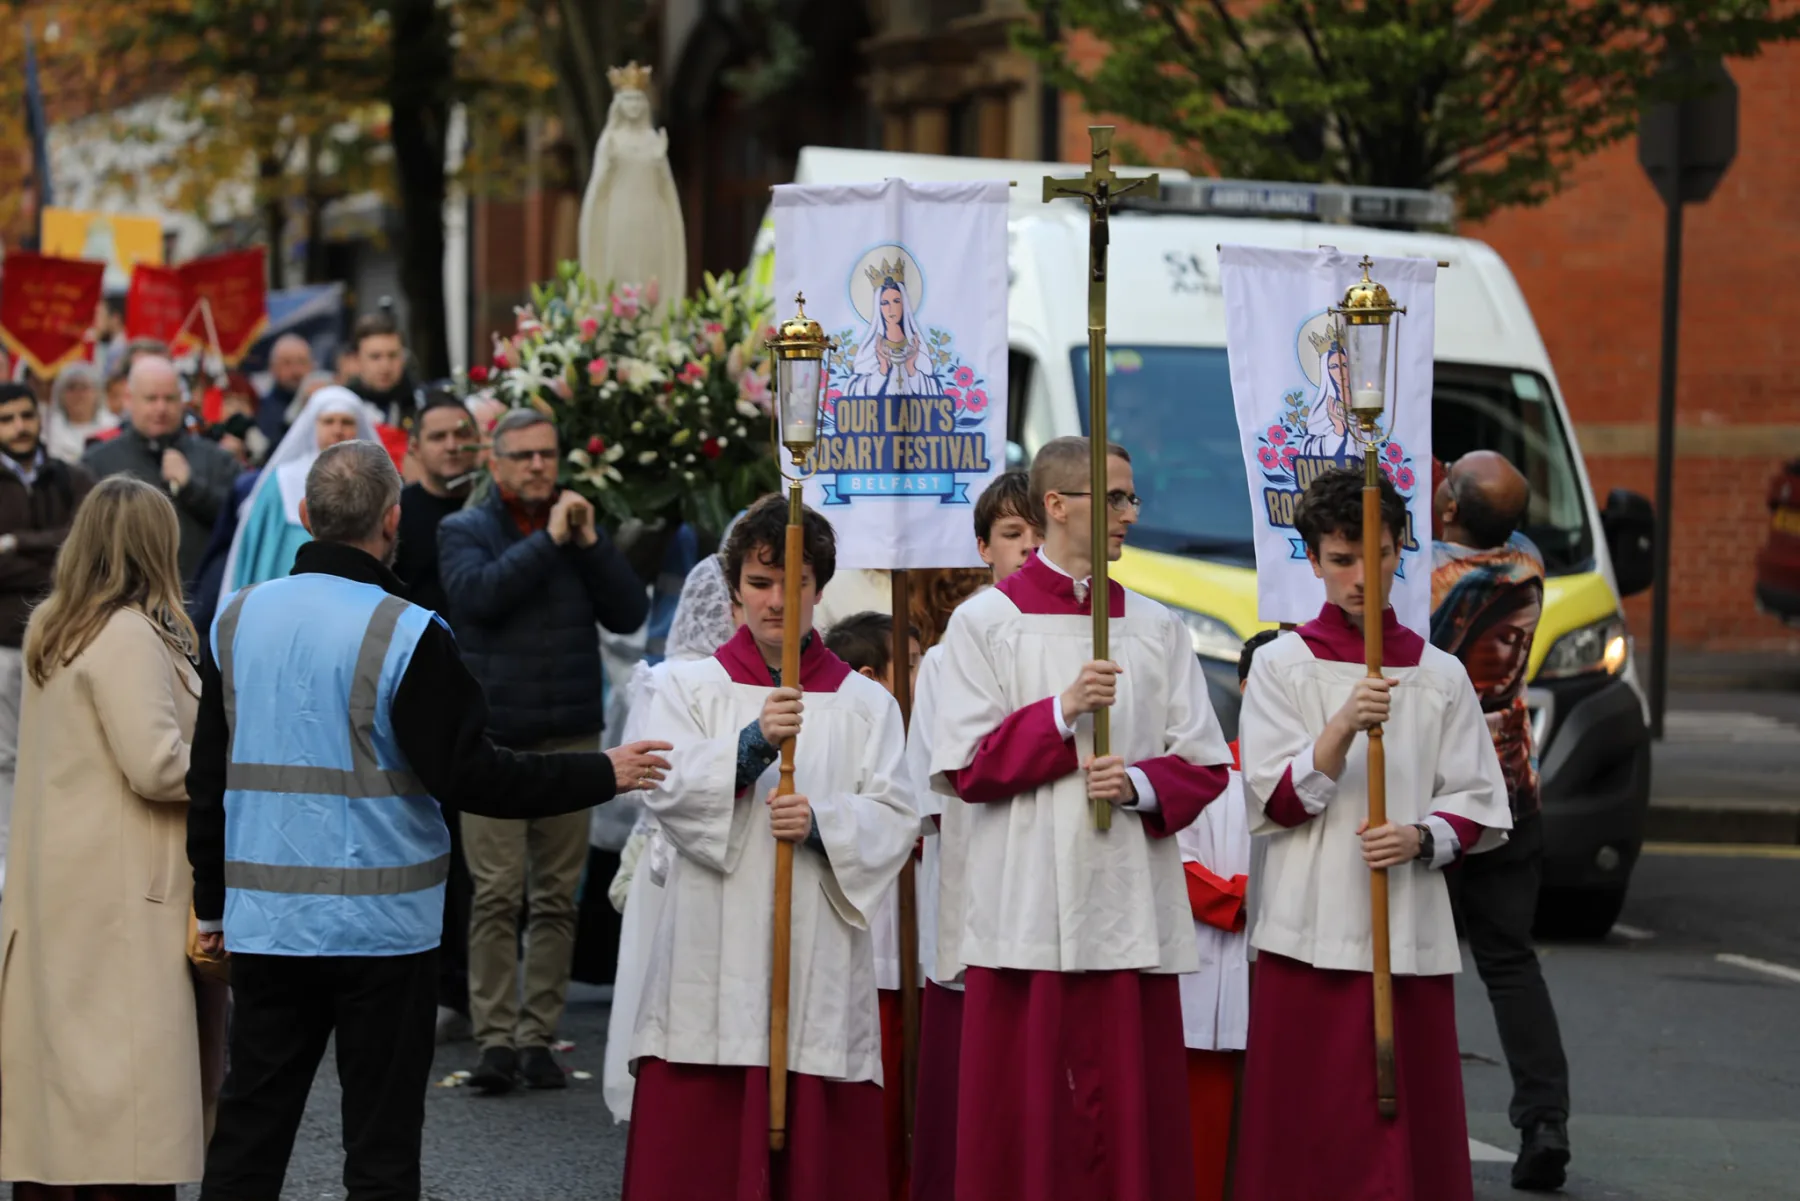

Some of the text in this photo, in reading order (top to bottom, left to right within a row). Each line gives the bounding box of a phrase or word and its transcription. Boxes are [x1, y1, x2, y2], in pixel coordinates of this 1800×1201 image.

[837, 398, 954, 433] OUR LADY'S
[893, 435, 988, 470] FESTIVAL
[852, 477, 941, 490] BELFAST
